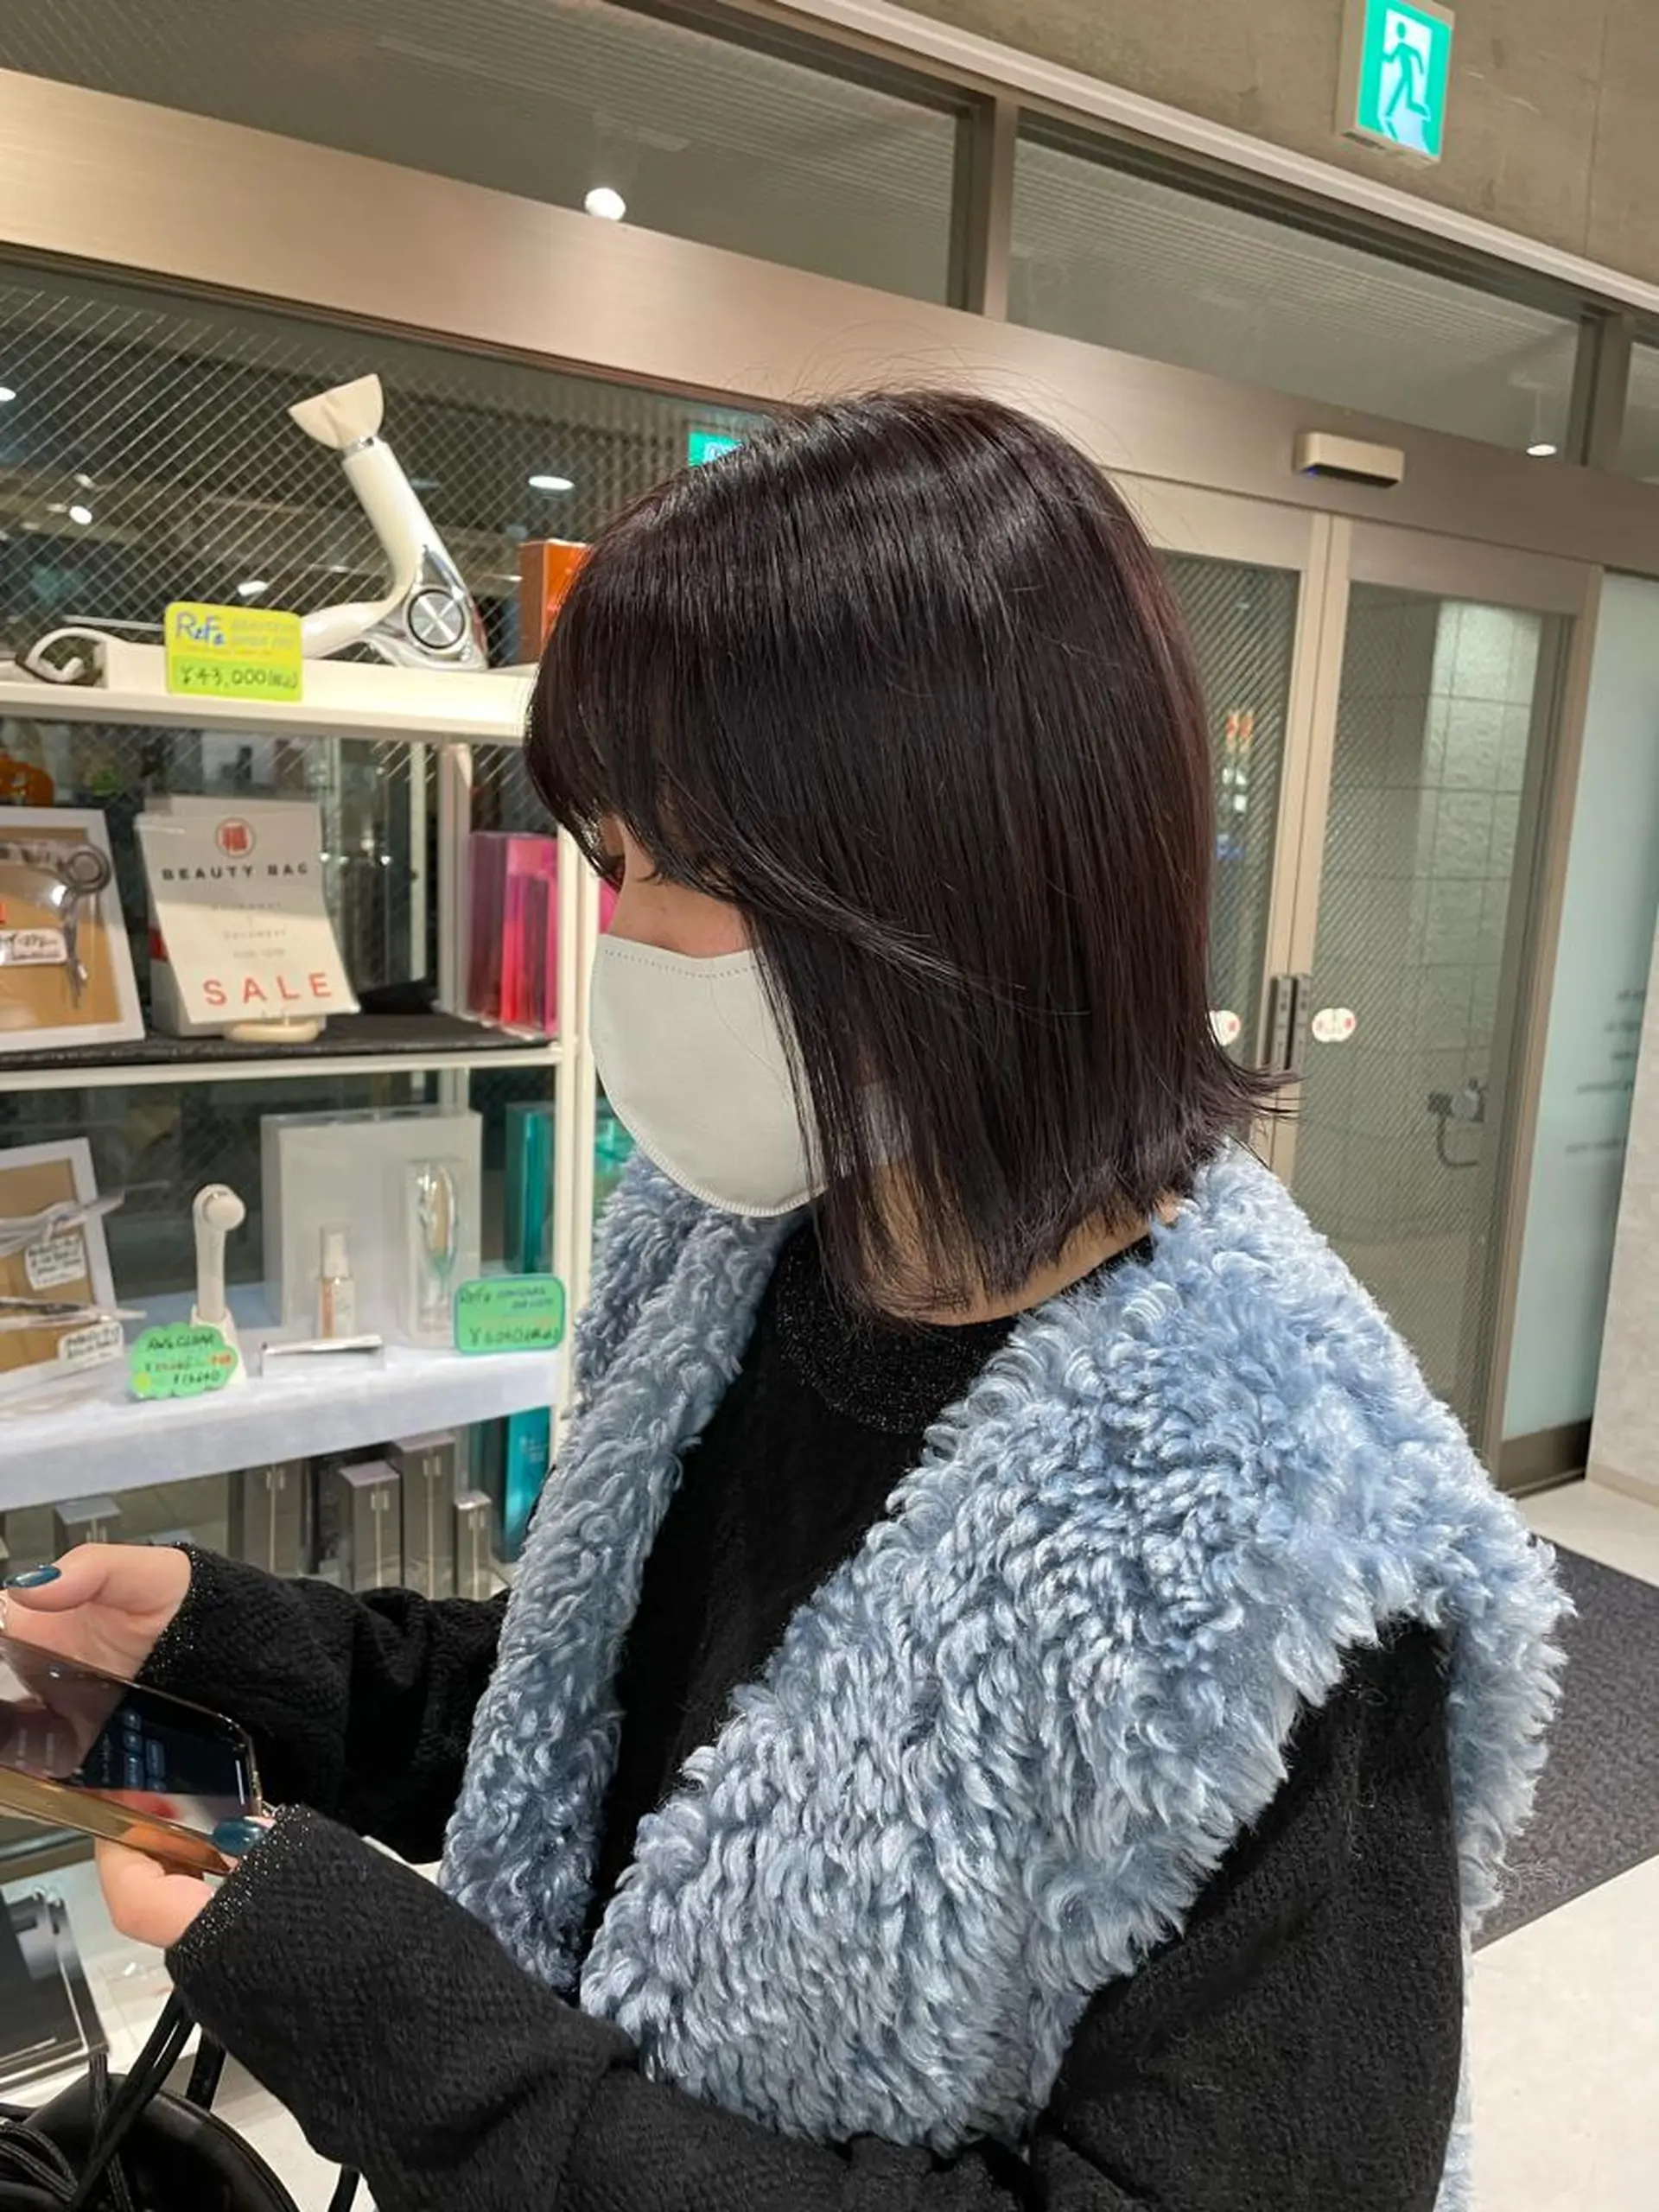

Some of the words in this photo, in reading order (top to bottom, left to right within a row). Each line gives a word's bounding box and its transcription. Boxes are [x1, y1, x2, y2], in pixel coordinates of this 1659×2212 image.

[162, 864, 253, 880] BEAUTY
[268, 863, 308, 876] BAG
[202, 972, 333, 1006] SALE
